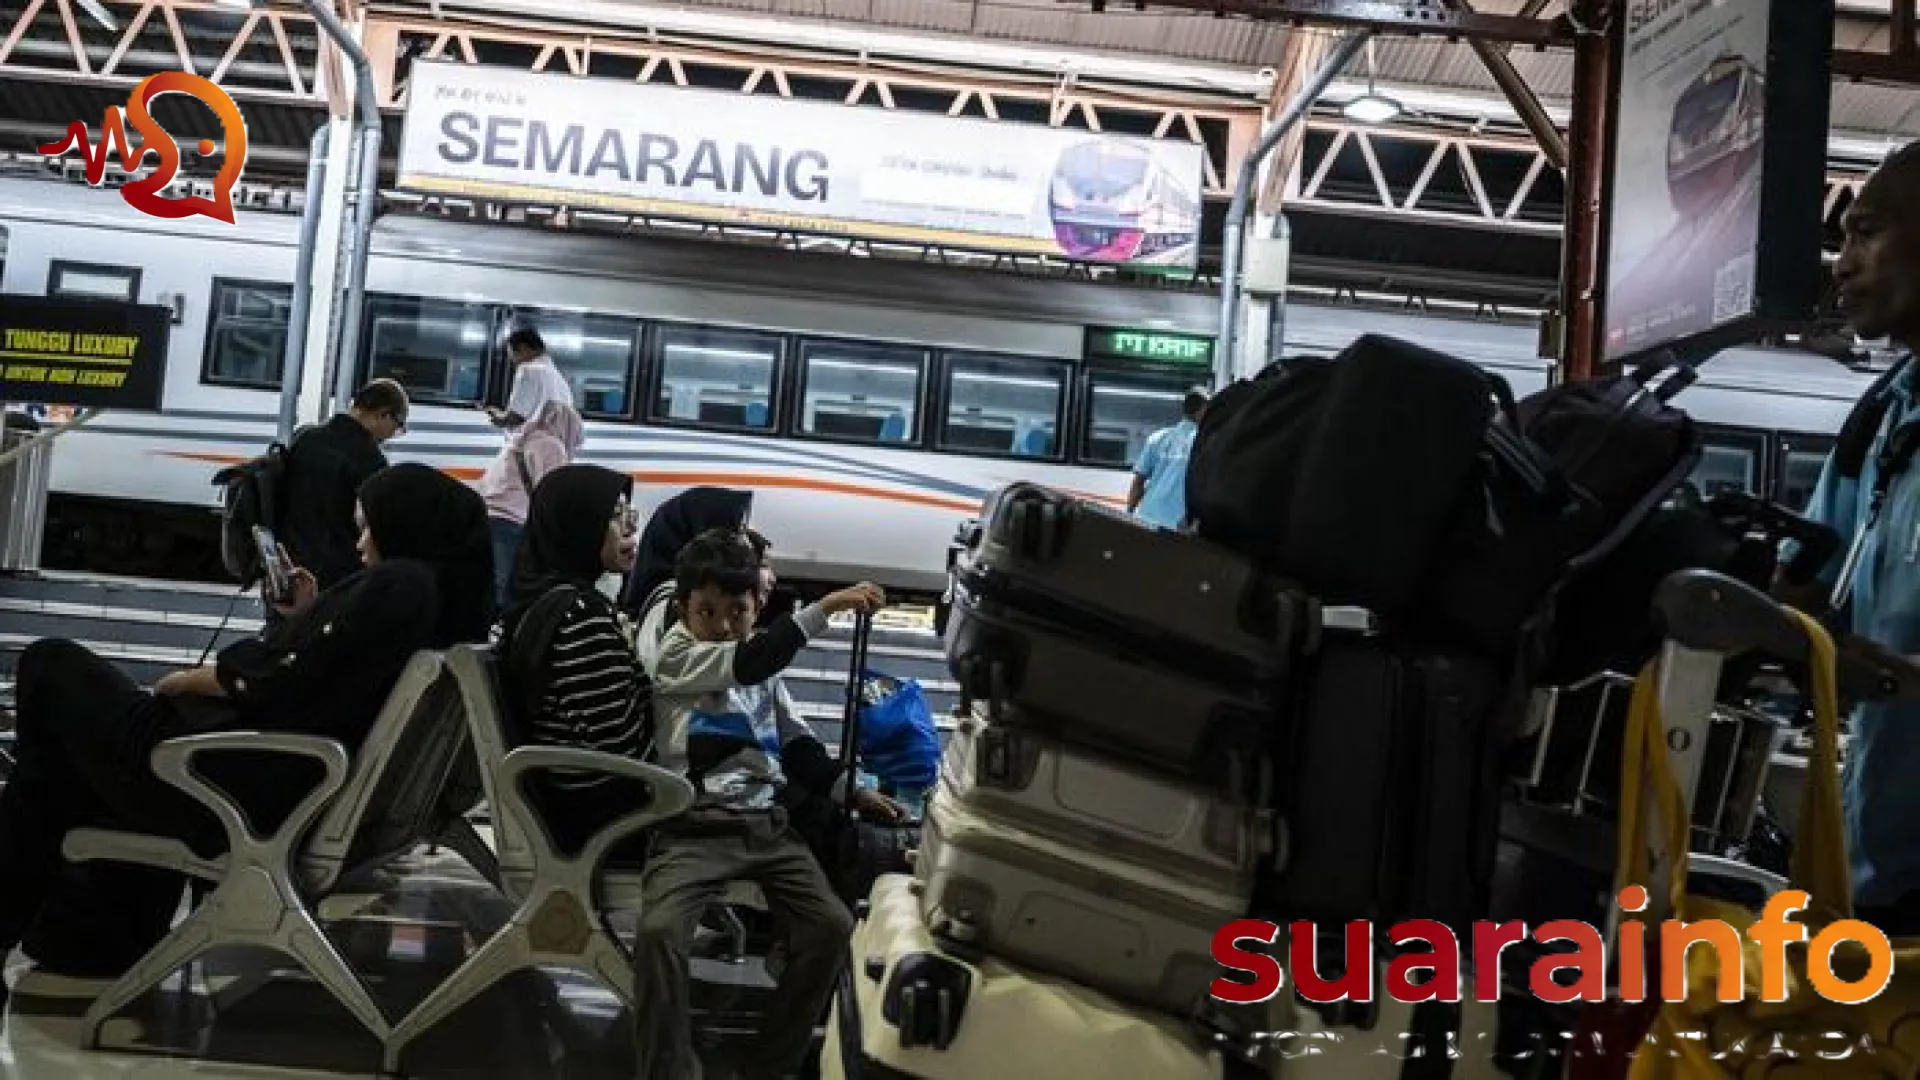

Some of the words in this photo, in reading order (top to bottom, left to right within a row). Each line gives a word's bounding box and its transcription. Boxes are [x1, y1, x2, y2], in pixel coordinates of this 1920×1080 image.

[438, 110, 830, 204] SEMARANG
[5, 328, 71, 351] TUNGGU
[74, 332, 139, 356] LUXURY
